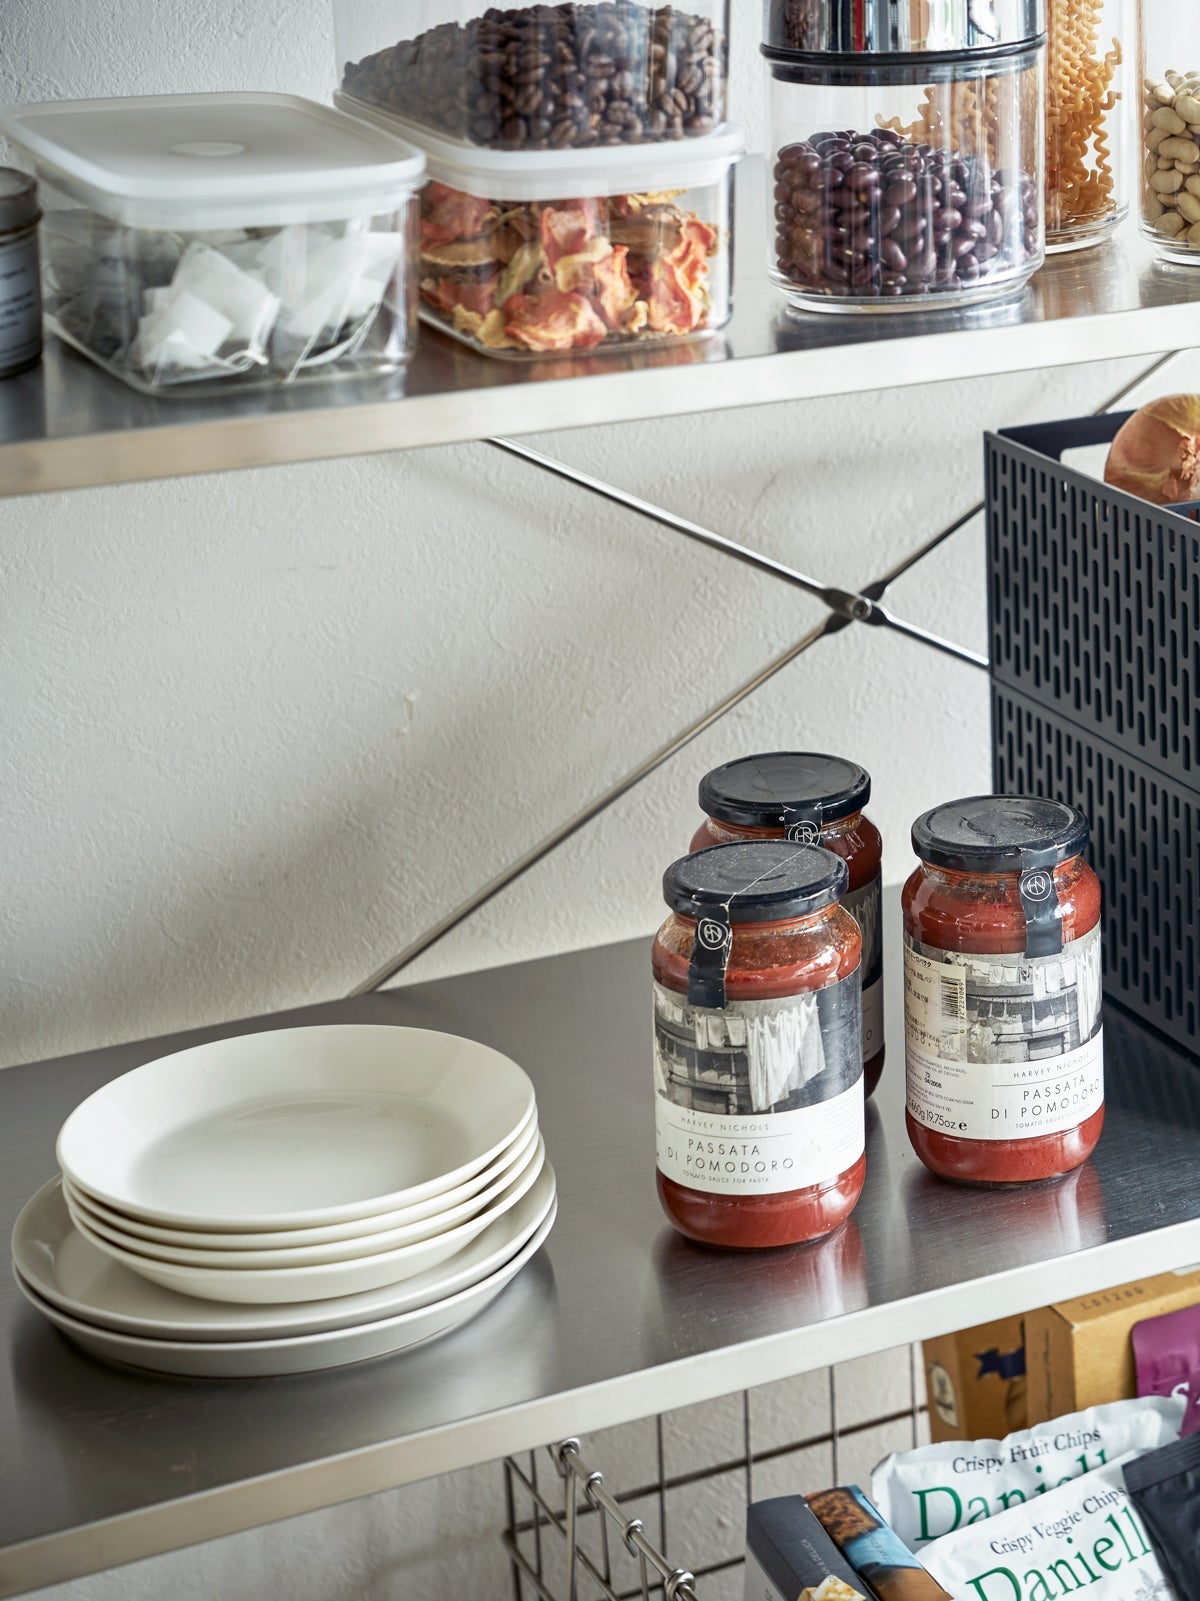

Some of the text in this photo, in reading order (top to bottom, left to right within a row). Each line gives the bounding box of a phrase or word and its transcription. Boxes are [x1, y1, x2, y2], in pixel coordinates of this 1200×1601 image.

[1013, 1067, 1051, 1079] HARVEY
[991, 1078, 1100, 1120] DI POMODORO
[1023, 1074, 1085, 1101] PASSATA
[680, 1117, 770, 1132] HARVEY NICHOLS
[926, 1109, 957, 1130] 19.75oz
[1015, 1120, 1043, 1129] TOMATO
[688, 1138, 761, 1156] PASSATA
[667, 1146, 678, 1161] DI
[686, 1154, 794, 1174] POMODORO
[708, 1175, 730, 1184] SAUCE
[952, 1427, 1101, 1475] Crispy Fruit Chips
[912, 1448, 1108, 1542] Dani
[989, 1485, 1127, 1555] Crispy Veggie Chips
